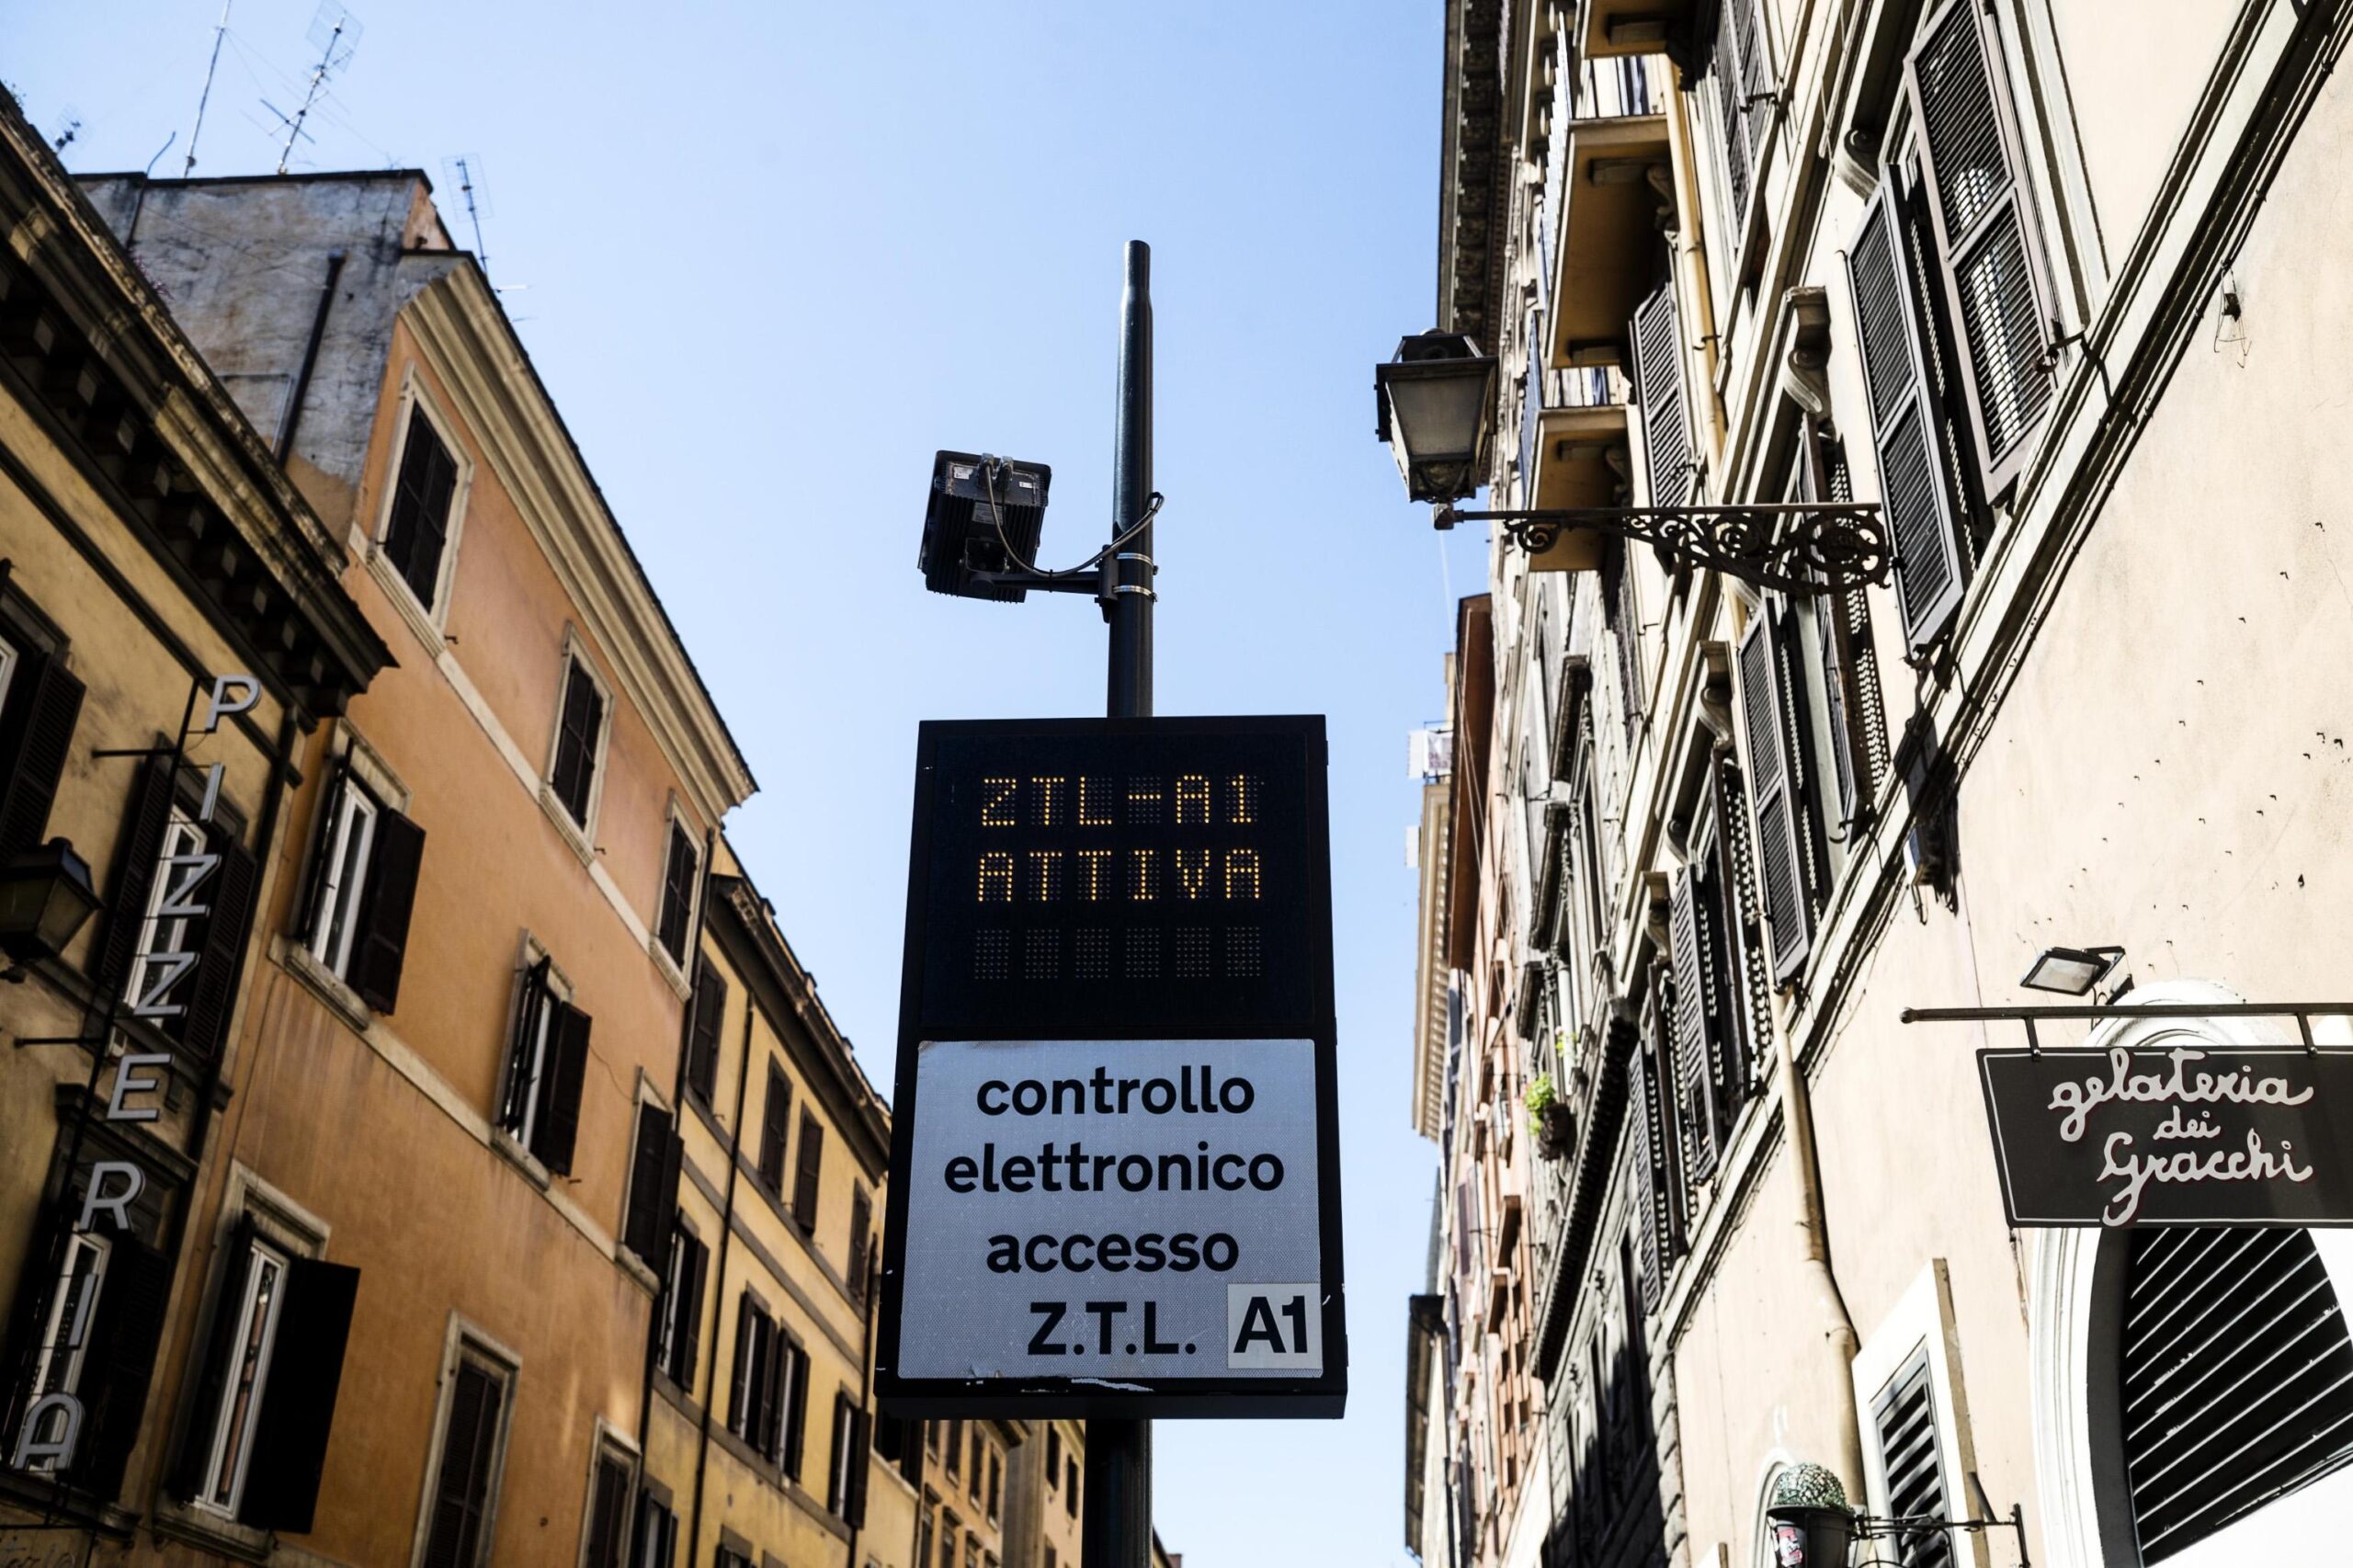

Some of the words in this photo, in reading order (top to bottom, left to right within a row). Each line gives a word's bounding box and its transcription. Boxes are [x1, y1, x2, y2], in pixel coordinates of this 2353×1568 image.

[981, 774, 1254, 826] ZTL-A1
[977, 848, 1260, 902] ATTIVA
[12, 675, 263, 1471] PIZZERIA
[976, 1065, 1256, 1116] controllo
[2153, 1105, 2222, 1140] dei
[944, 1141, 1285, 1194] elettronico
[2096, 1128, 2313, 1227] Gracchi
[986, 1233, 1239, 1274] accesso
[1027, 1301, 1198, 1356] Z.T.L.
[1233, 1295, 1309, 1355] A1
